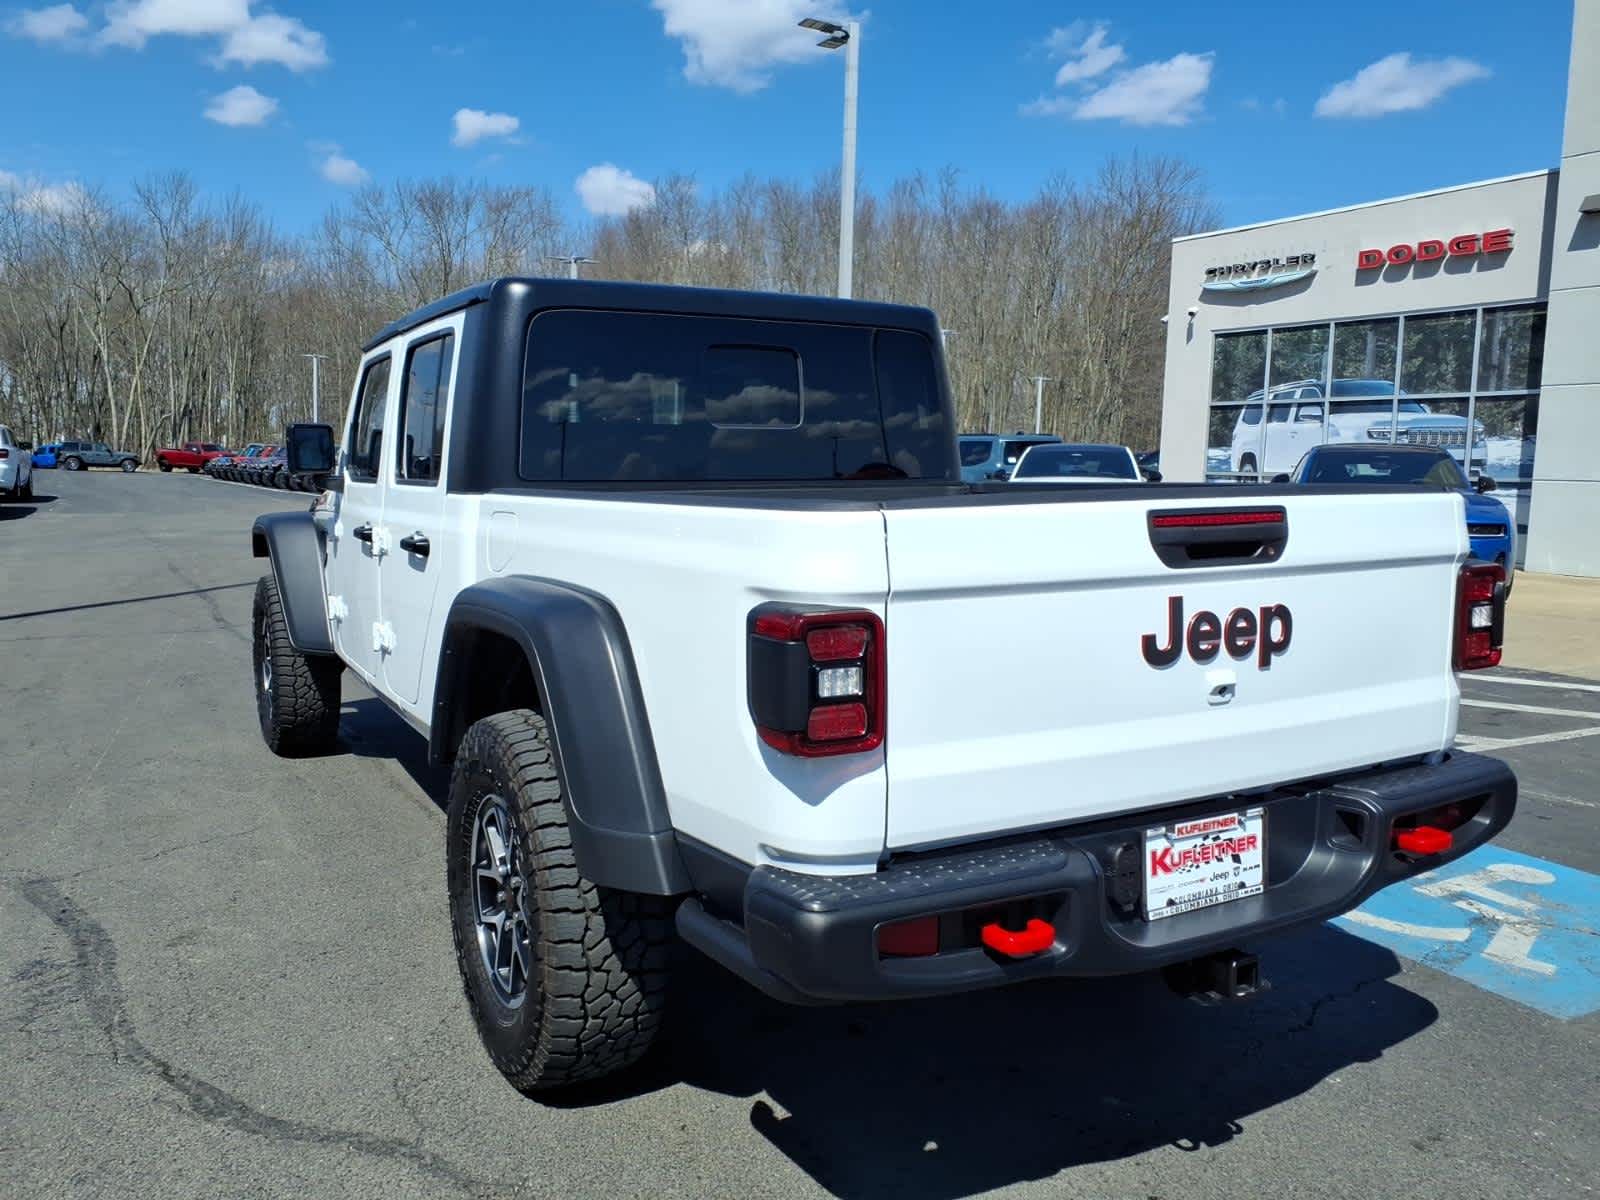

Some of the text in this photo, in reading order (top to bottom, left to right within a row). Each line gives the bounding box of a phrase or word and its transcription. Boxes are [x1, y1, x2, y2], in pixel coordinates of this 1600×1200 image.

[1358, 228, 1515, 270] DODGE
[1205, 253, 1316, 276] CHRYSLER
[1141, 596, 1293, 671] Jeep
[1176, 816, 1236, 836] KUFLEITNER
[1151, 835, 1257, 877] KUFLEITNER
[1210, 871, 1230, 882] Jeep
[1223, 891, 1240, 901] OHIO
